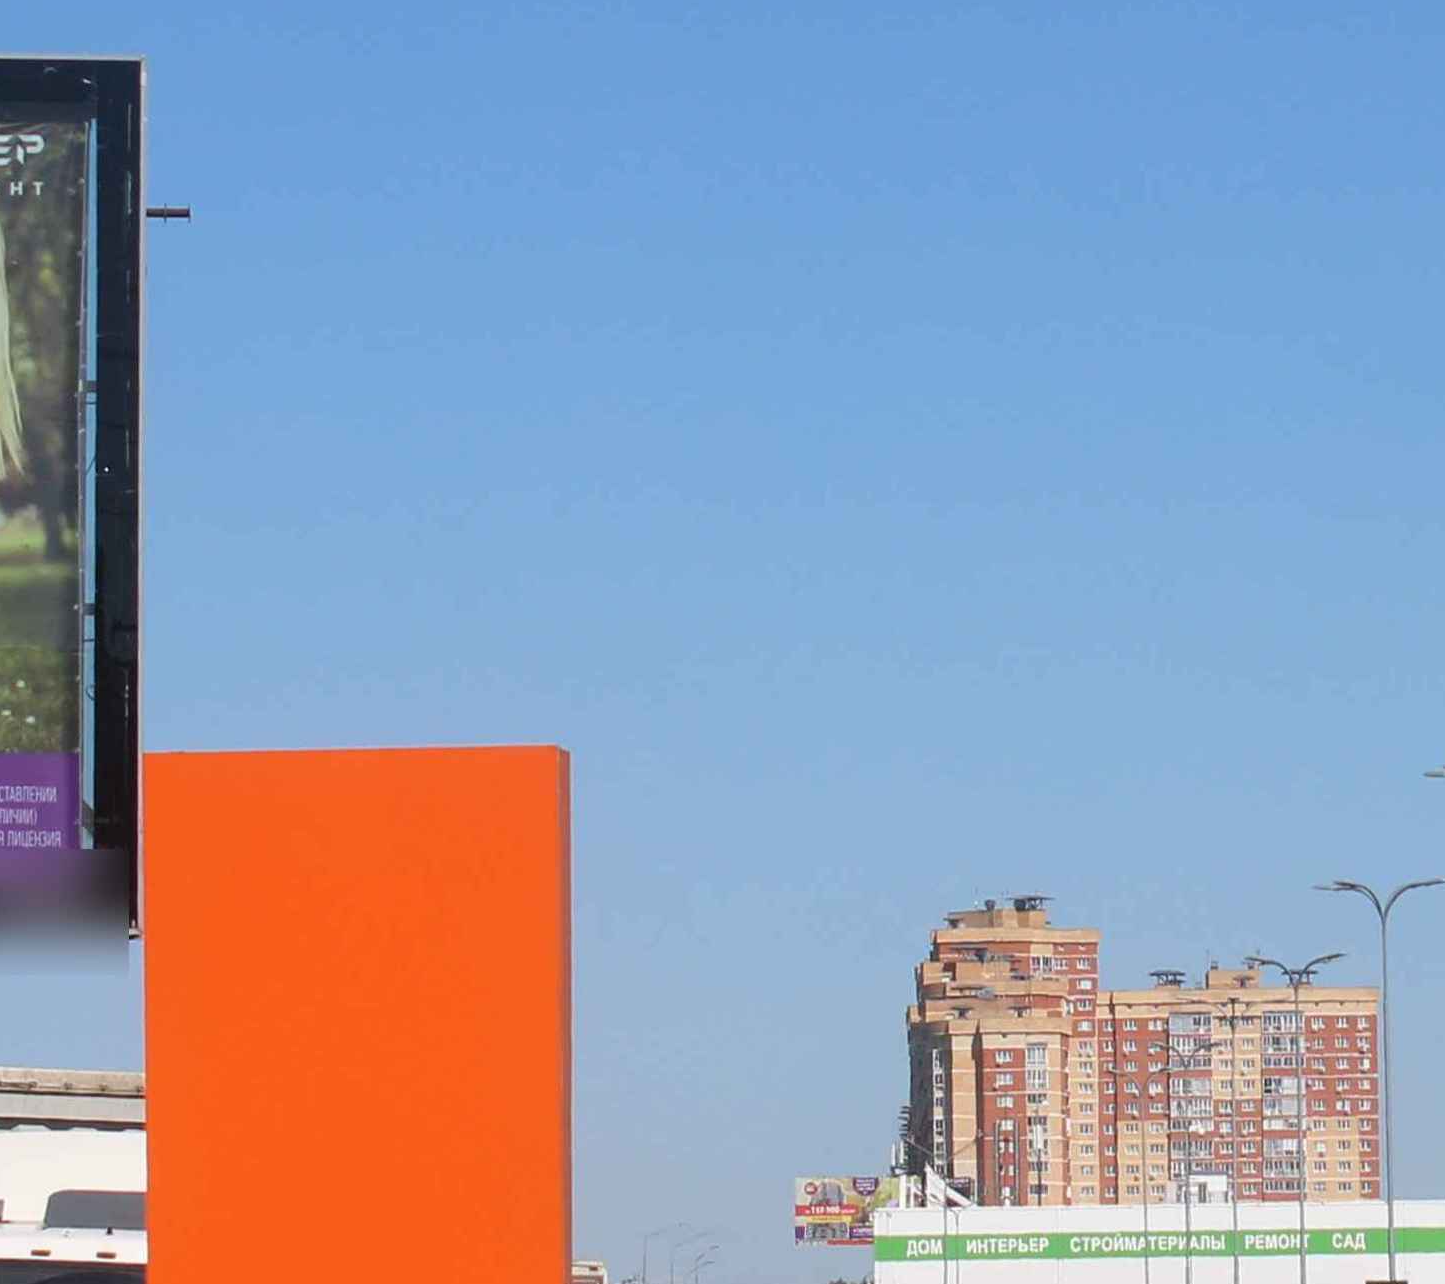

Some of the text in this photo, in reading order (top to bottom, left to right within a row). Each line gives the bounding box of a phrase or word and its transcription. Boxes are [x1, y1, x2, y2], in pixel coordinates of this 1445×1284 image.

[7, 830, 62, 848] ЛИЦЕНЗИЯ
[906, 1238, 943, 1258] ДОМ
[965, 1237, 1049, 1255] ИНТЕРЬЕР
[1069, 1232, 1226, 1254] СТРОЙМАТЕРИАЛЫ
[1332, 1232, 1367, 1250] САД
